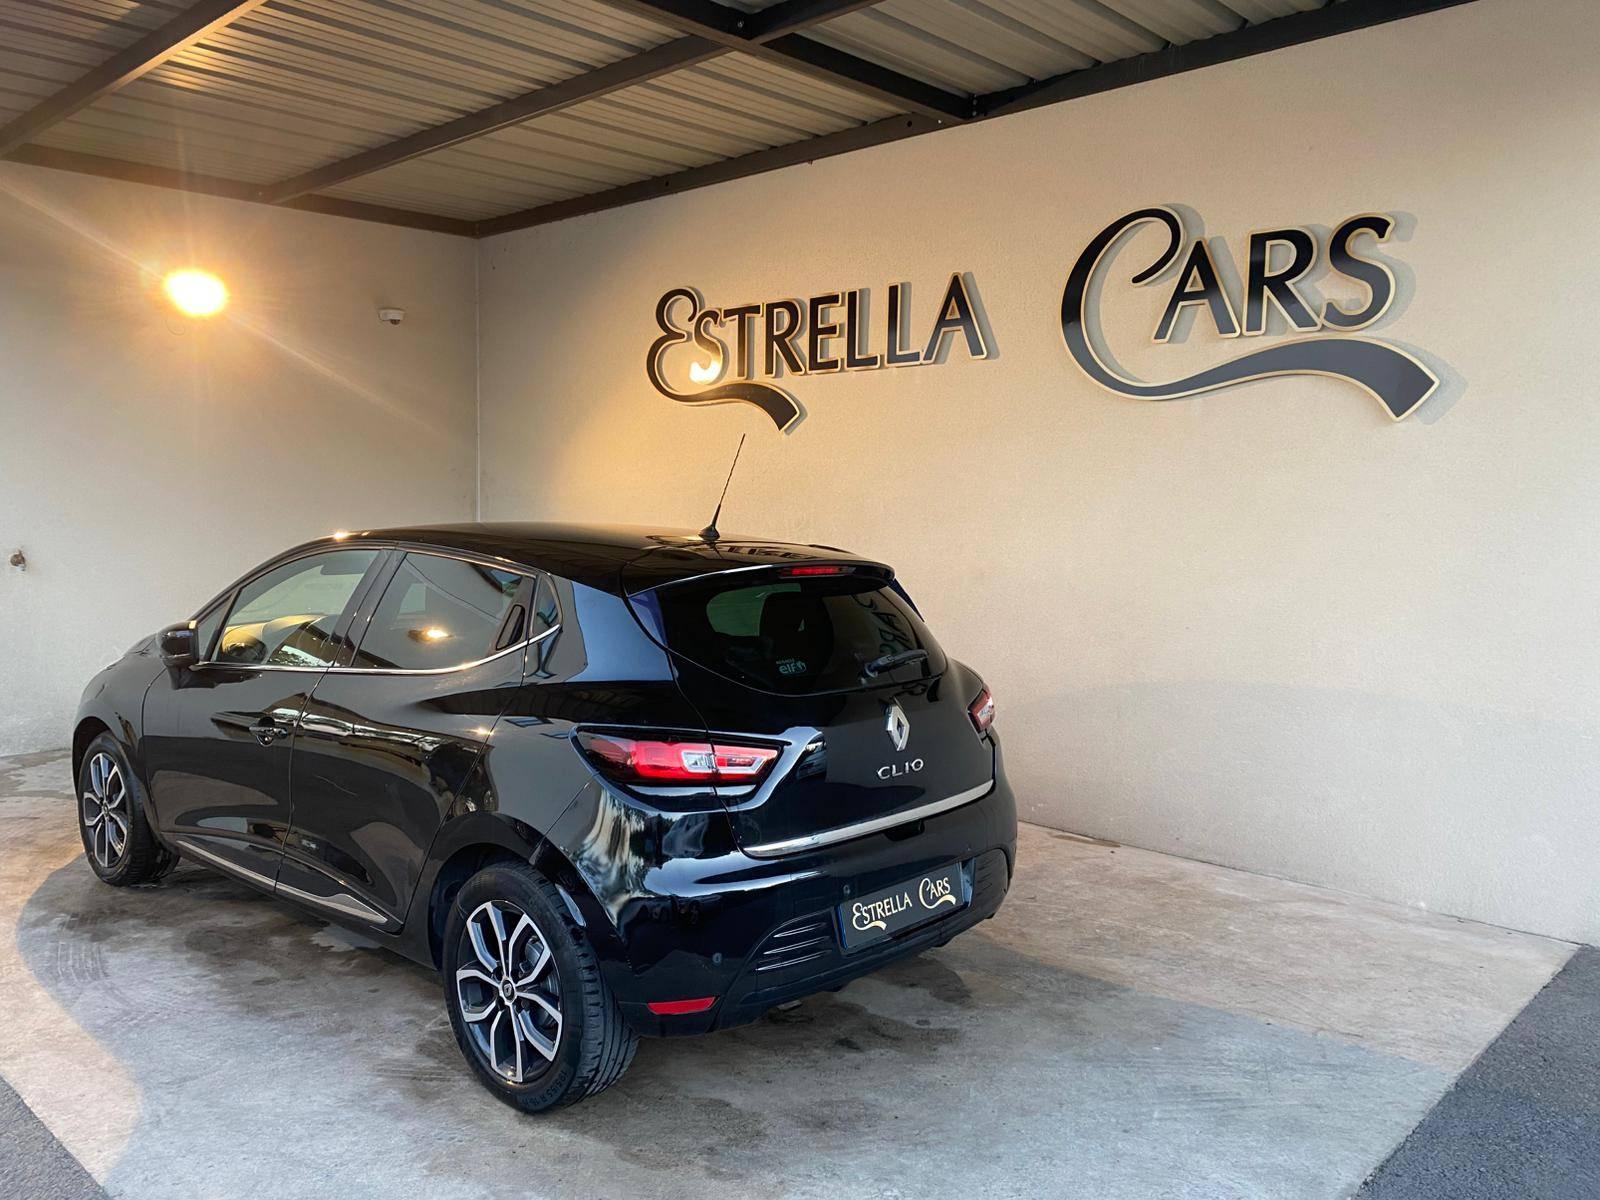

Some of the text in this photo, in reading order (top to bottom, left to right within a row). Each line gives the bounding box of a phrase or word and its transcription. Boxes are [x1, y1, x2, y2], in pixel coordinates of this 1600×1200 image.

[646, 206, 1440, 431] ESTRELLA CARS
[877, 758, 924, 780] CLIO
[852, 877, 956, 930] ESTRELLA CARS
